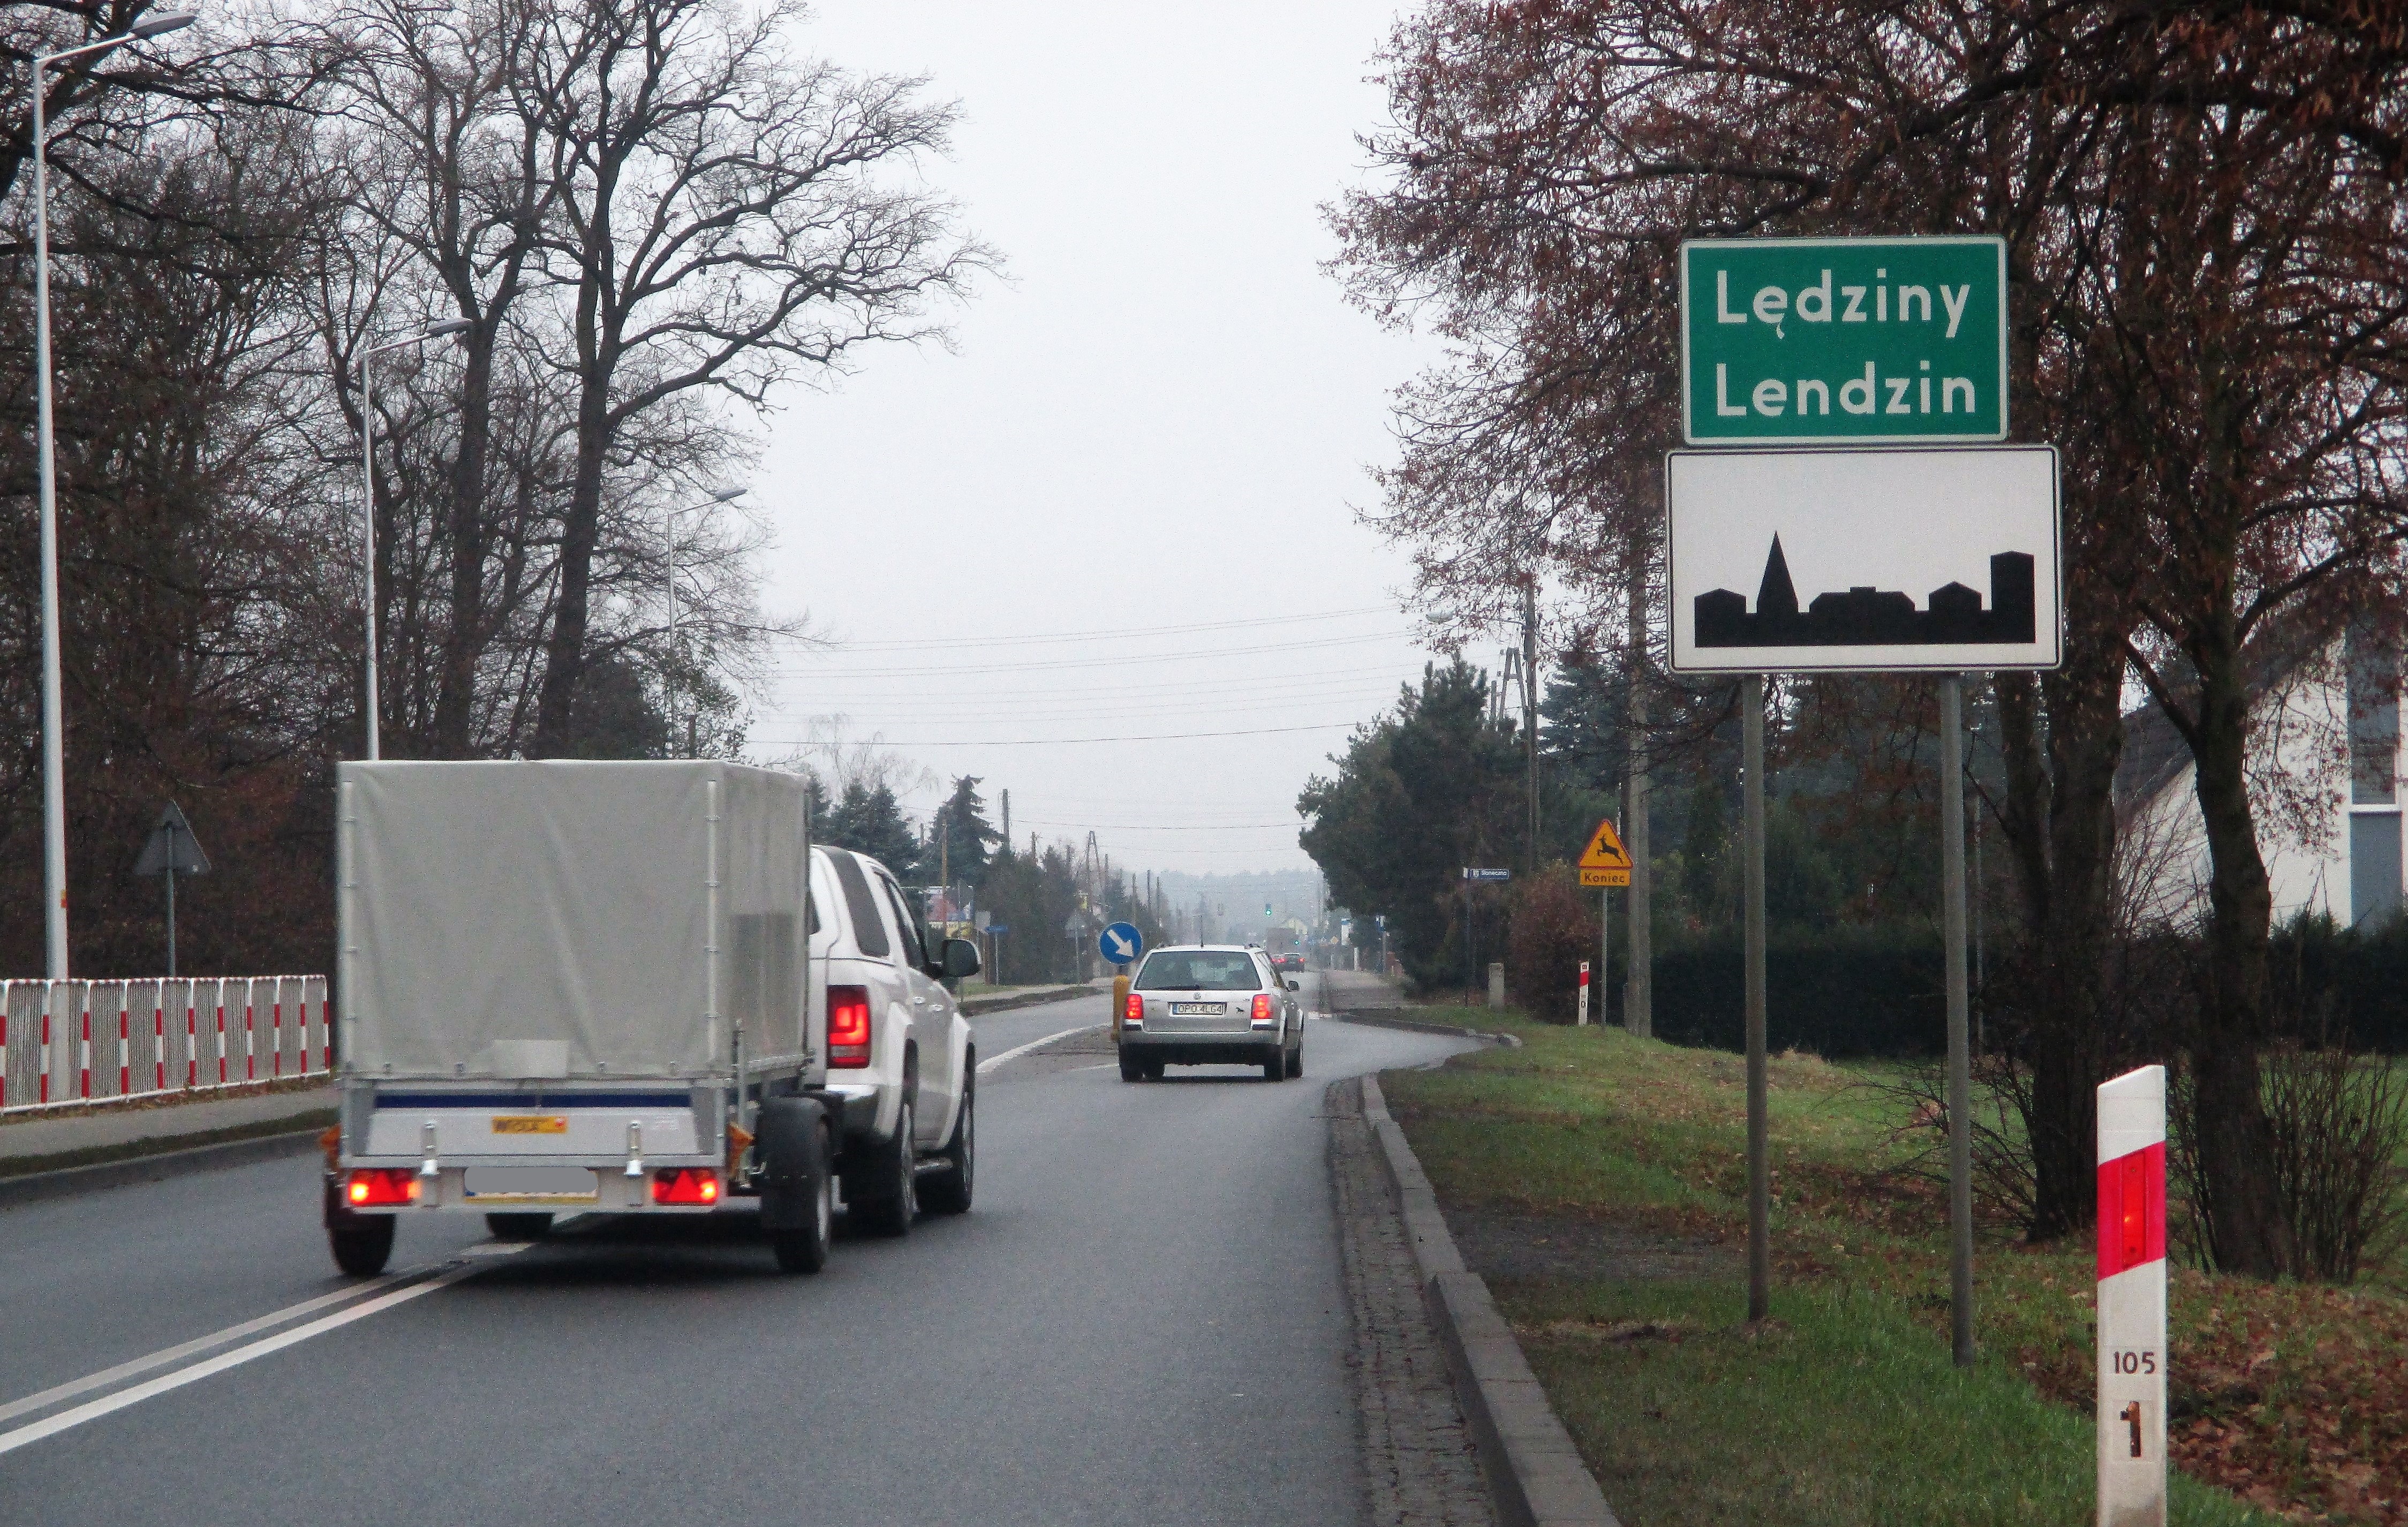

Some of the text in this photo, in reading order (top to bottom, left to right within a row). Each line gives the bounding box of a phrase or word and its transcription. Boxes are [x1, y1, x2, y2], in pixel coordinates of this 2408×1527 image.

[1717, 269, 1971, 339] Lędziny
[1717, 360, 1976, 417] Lendzin
[1585, 873, 1625, 882] Koniec
[2114, 1351, 2155, 1374] 105
[2120, 1401, 2141, 1457] 1
